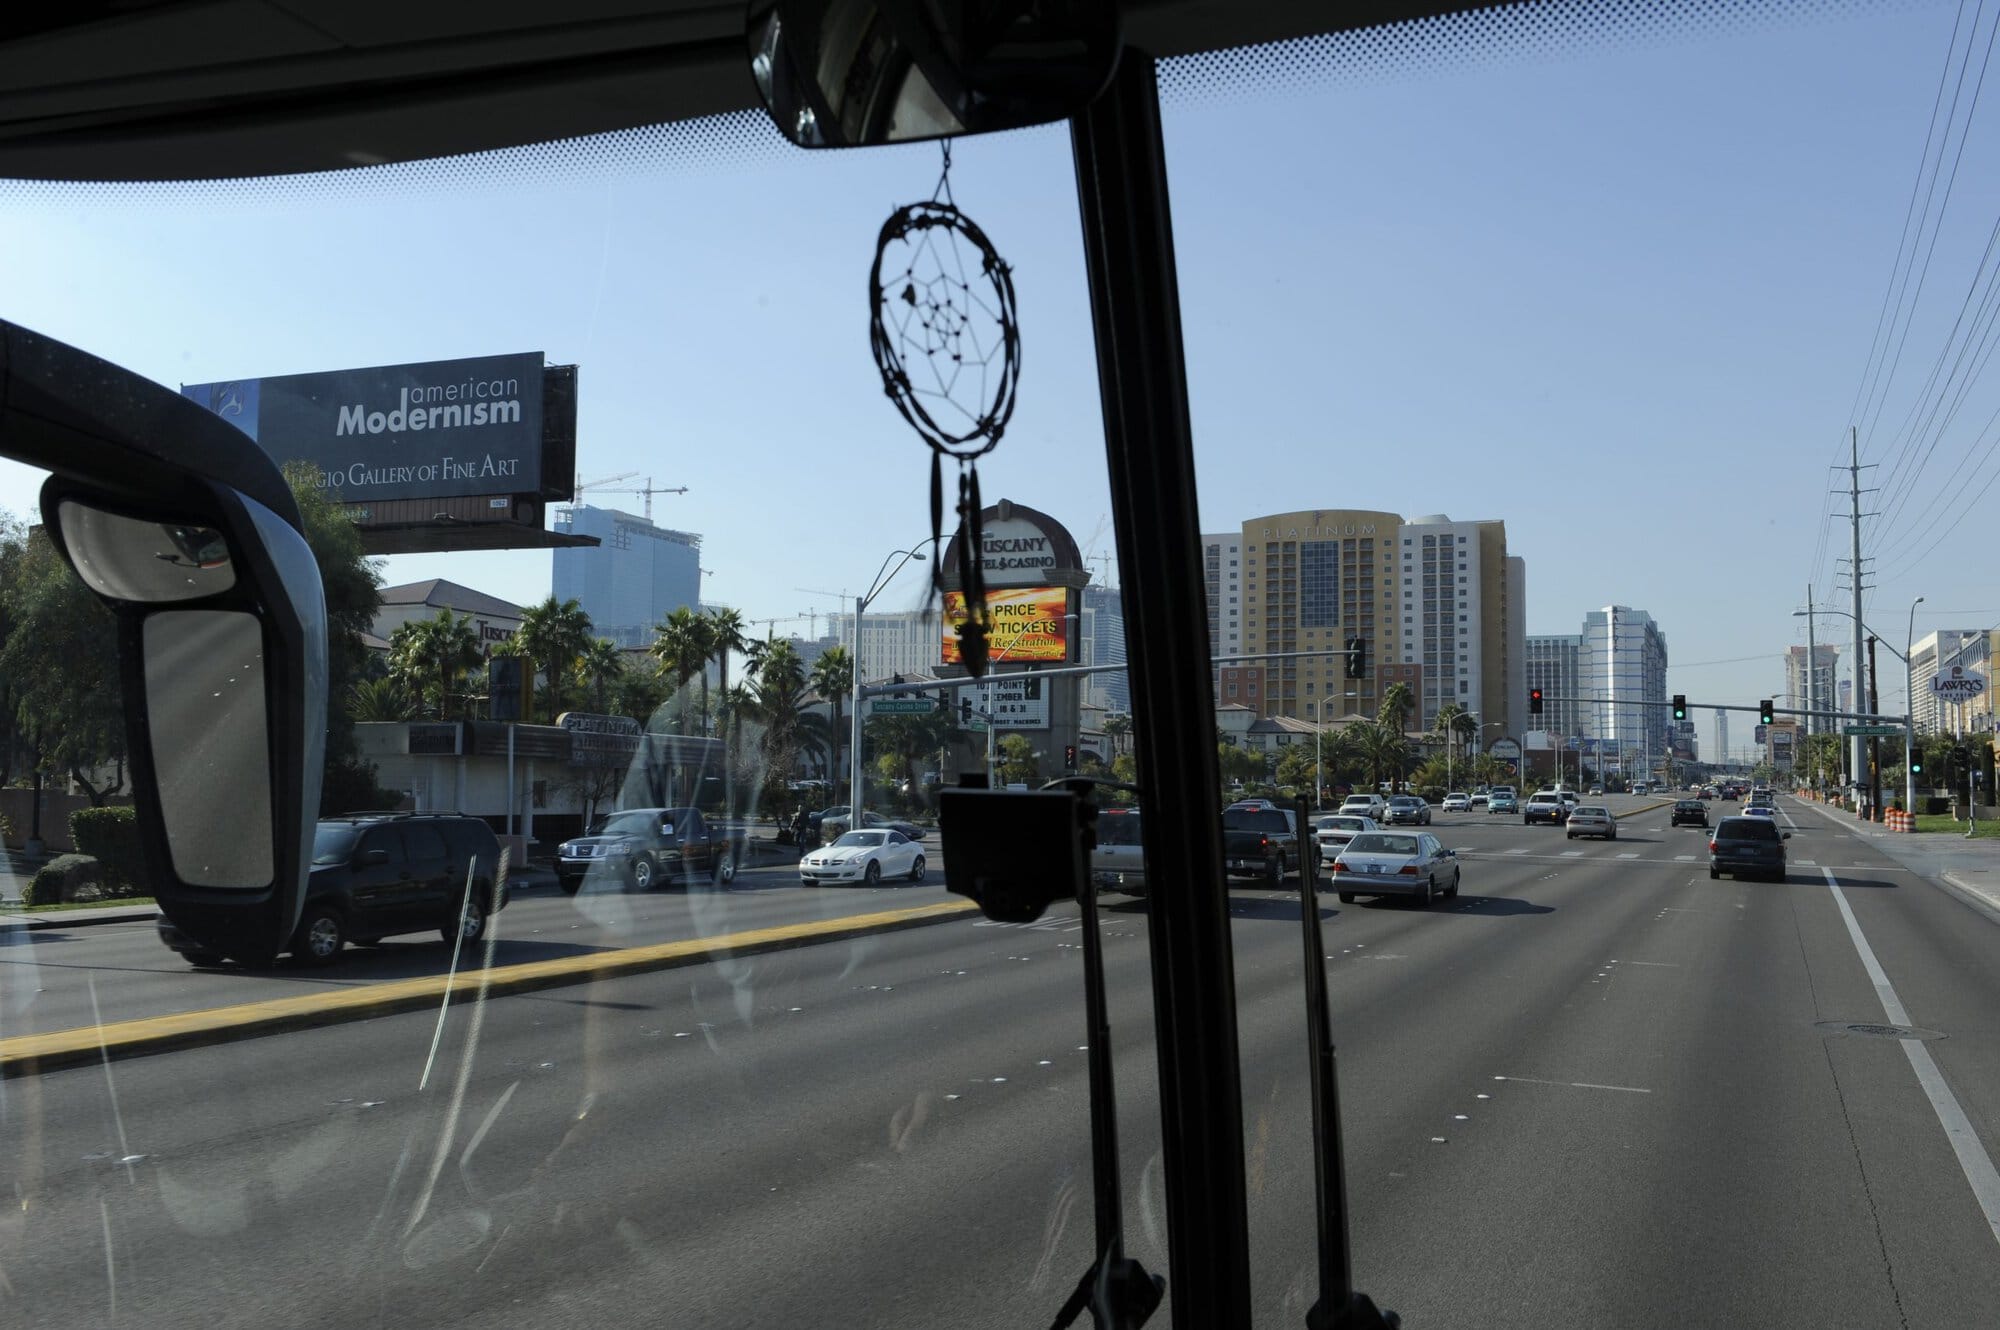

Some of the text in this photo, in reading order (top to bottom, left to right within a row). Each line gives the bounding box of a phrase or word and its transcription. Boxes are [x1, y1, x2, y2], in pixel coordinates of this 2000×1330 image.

[410, 377, 518, 403] american
[336, 388, 521, 436] Modernism
[348, 463, 415, 486] GALLERY
[418, 464, 438, 482] OF
[442, 457, 476, 480] FINE
[480, 453, 519, 477] ART
[1262, 524, 1377, 539] PLATINUM
[983, 537, 1047, 553] USCANY
[994, 603, 1036, 617] PRICE
[1000, 620, 1057, 634] TICKETS
[1933, 677, 1983, 693] LAWRY'S
